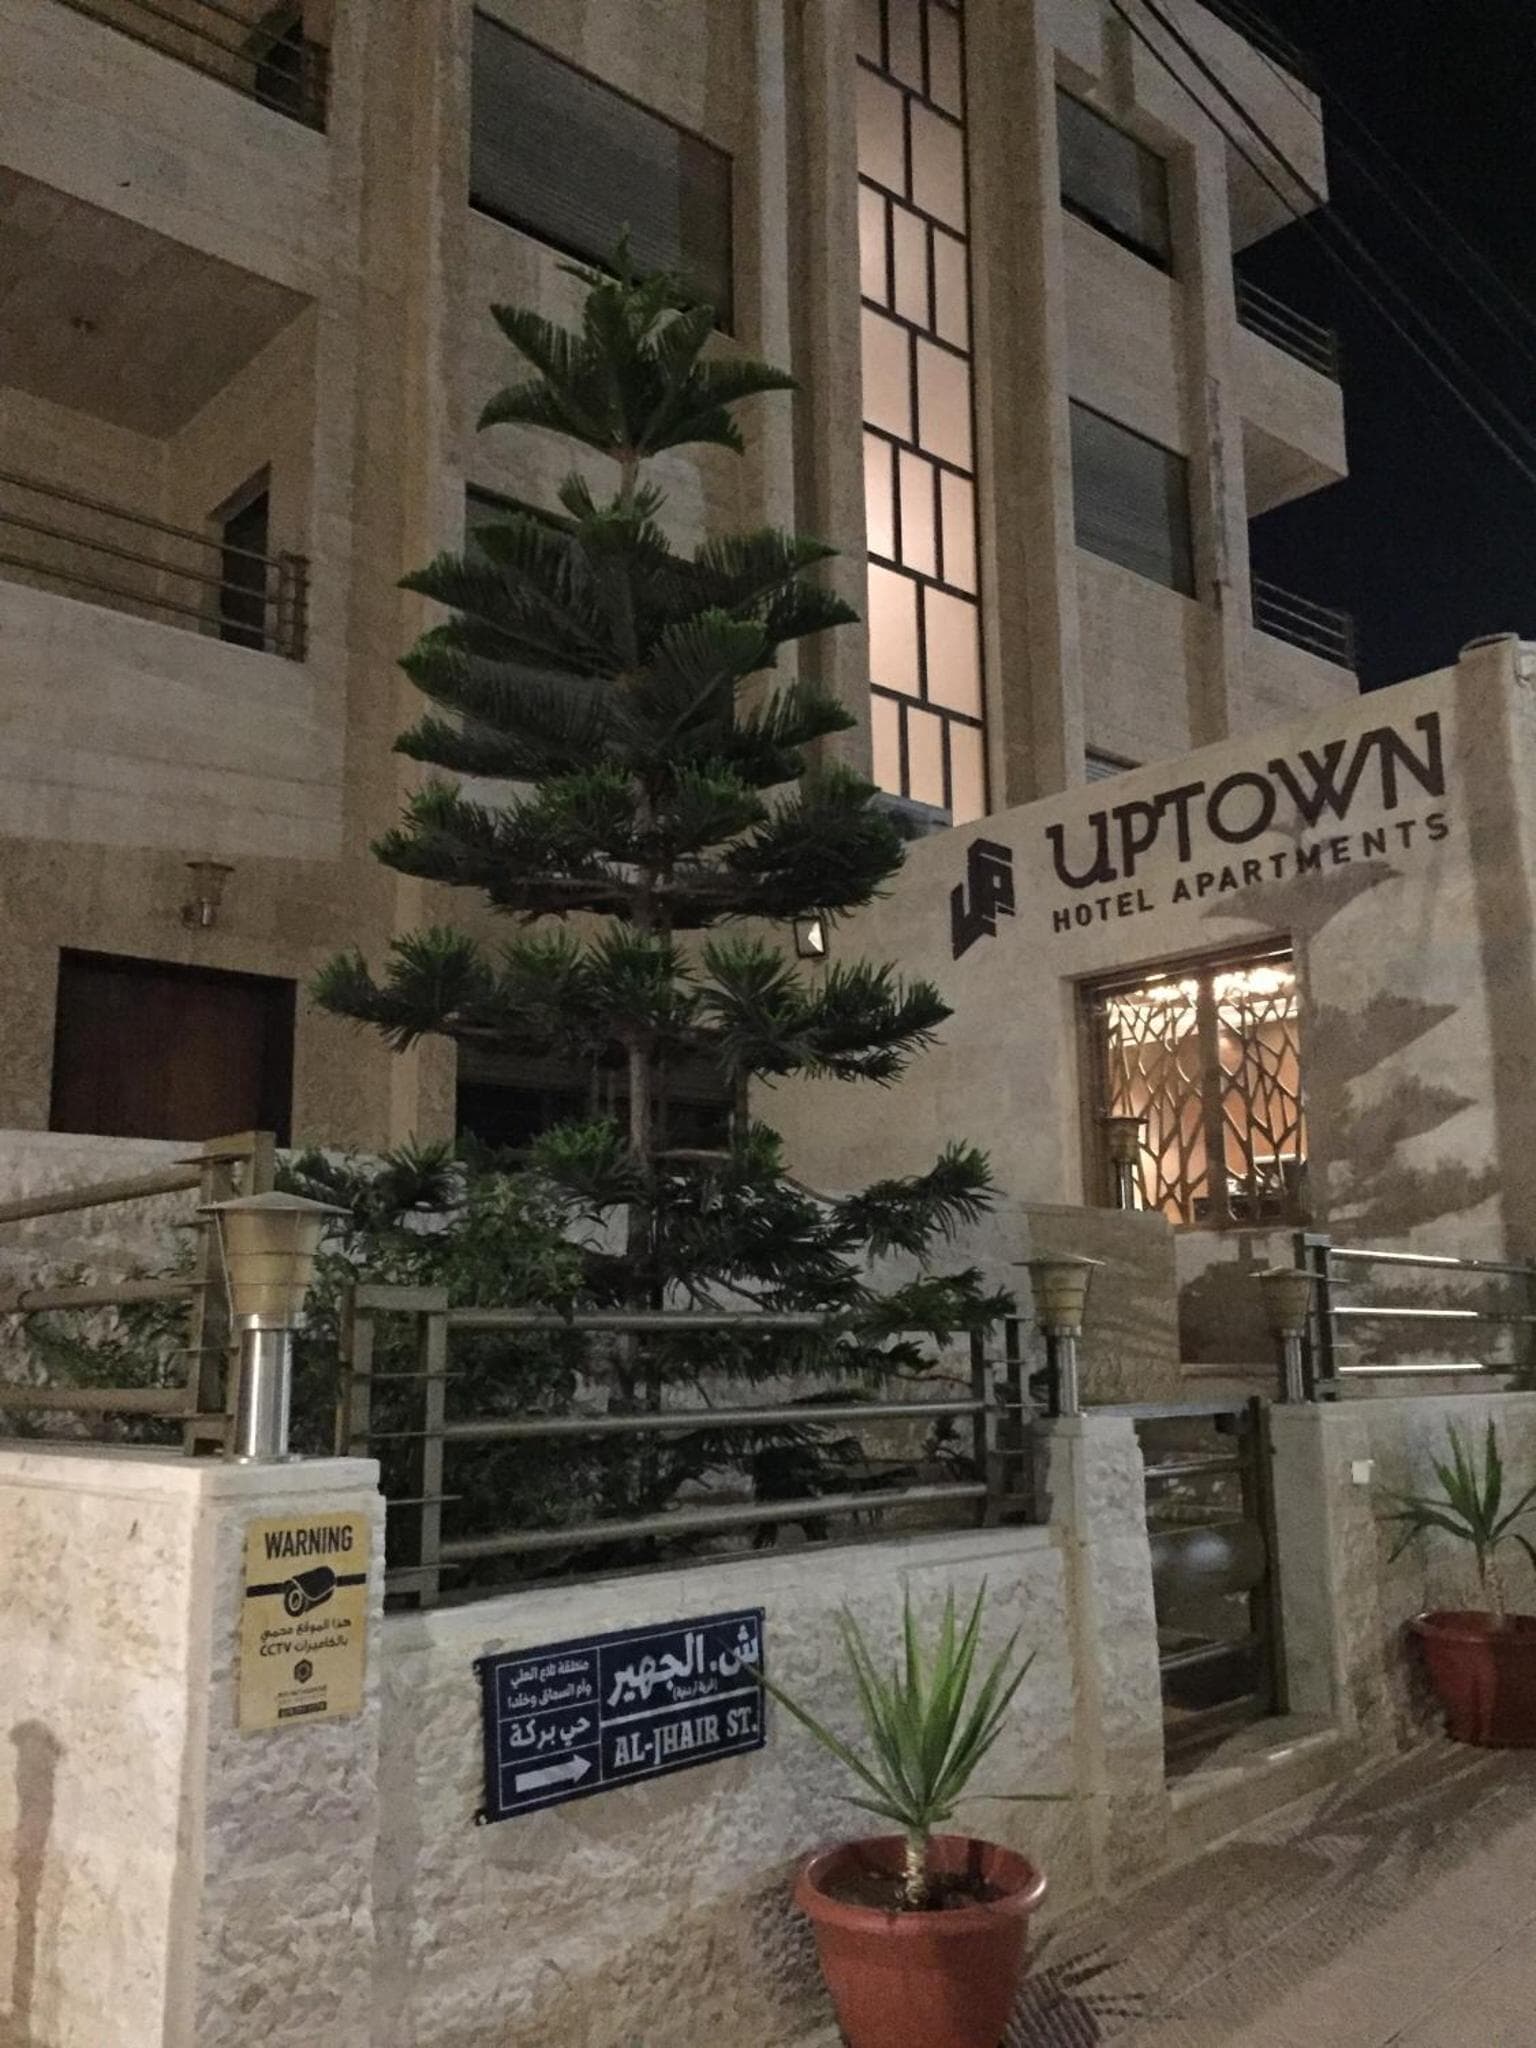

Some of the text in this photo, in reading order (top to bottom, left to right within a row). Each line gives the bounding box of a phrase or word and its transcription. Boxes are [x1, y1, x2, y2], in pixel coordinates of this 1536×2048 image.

[1046, 711, 1446, 889] UPTOWN
[1053, 812, 1450, 934] HOTEL APARTMENTS
[264, 1525, 354, 1560] WARNING
[259, 1617, 353, 1642] هذا الموقع محمي
[259, 1636, 349, 1657] بالكاميرات CCTV
[510, 1666, 538, 1689] العلي
[557, 1659, 590, 1675] منطقة
[607, 1631, 705, 1708] الجهير
[509, 1717, 591, 1750] حي بركة
[613, 1706, 759, 1768] AL-JHAIR ST.
